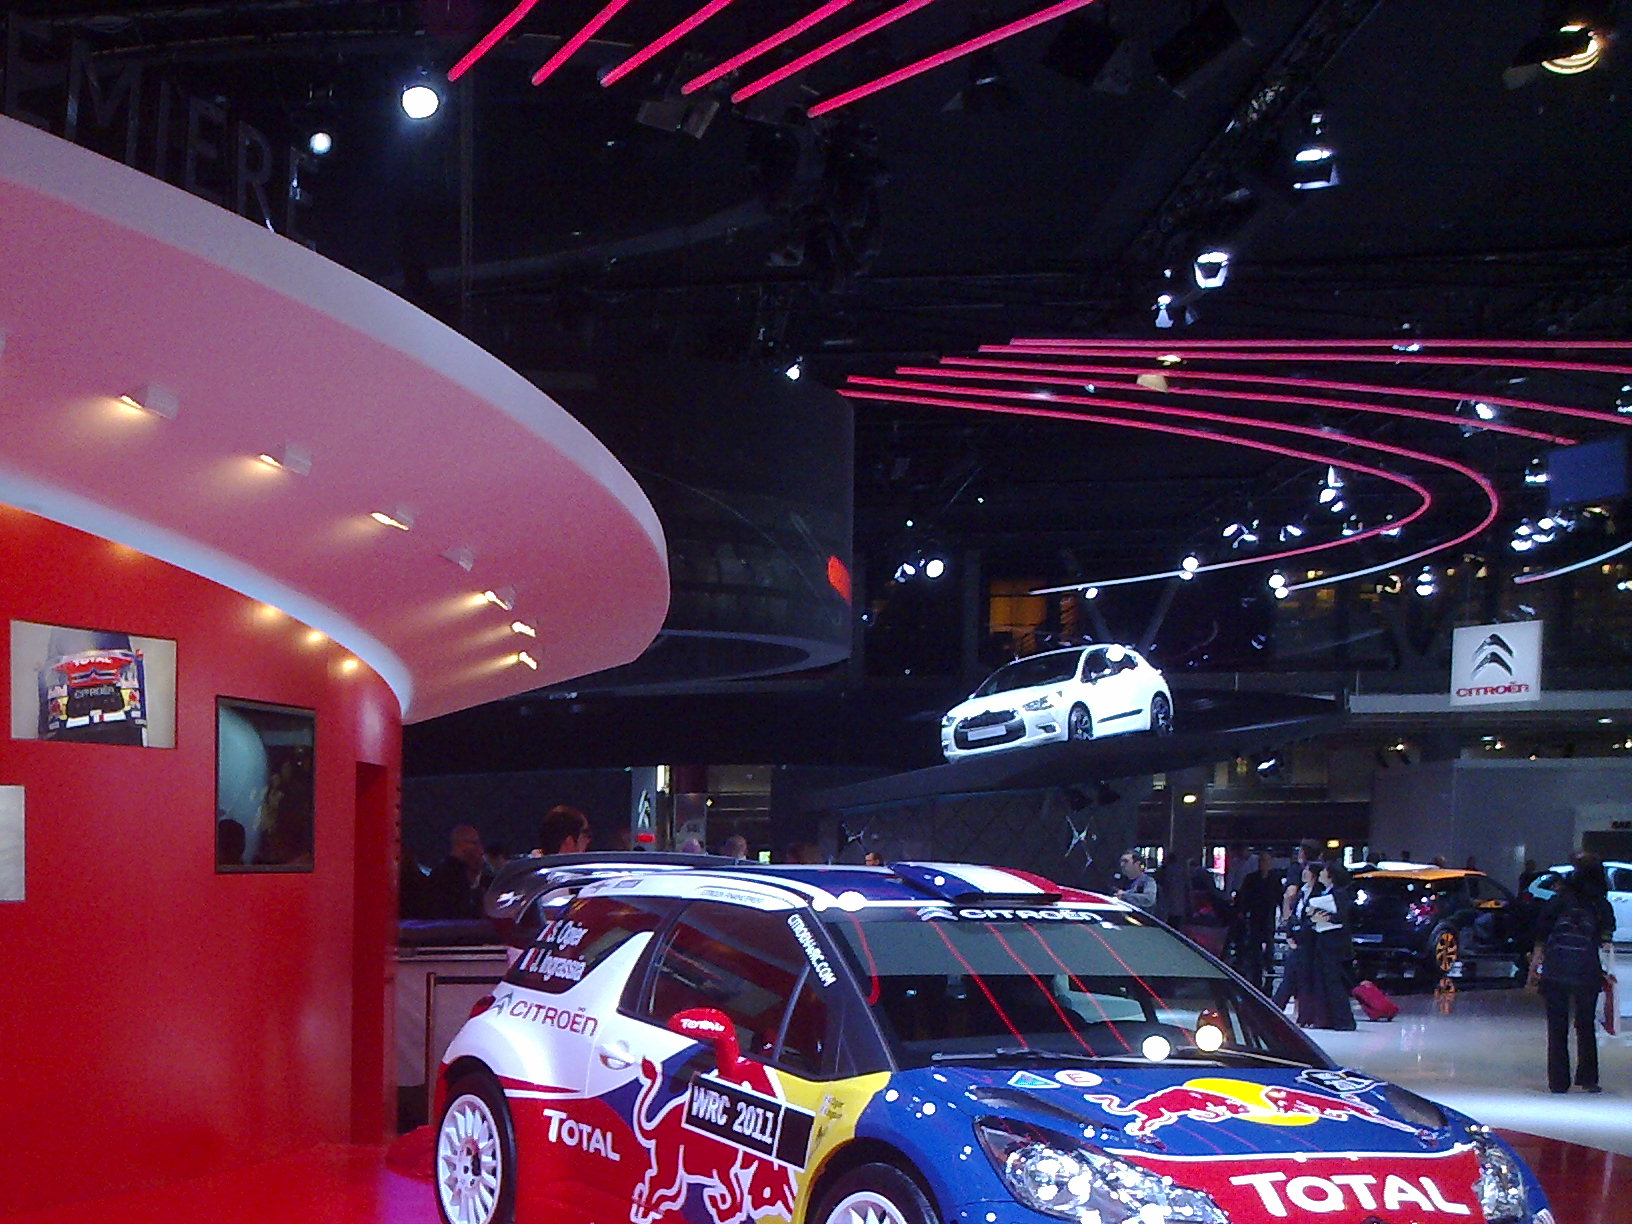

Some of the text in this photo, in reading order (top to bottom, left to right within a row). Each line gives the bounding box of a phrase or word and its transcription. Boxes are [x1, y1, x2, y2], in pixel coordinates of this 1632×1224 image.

[1455, 682, 1529, 698] CITROËN
[959, 908, 1103, 921] CITROËN
[509, 1000, 599, 1037] CITROËN
[543, 1108, 621, 1163] TOTAL
[691, 1085, 732, 1127] WRC
[732, 1101, 775, 1145] 2011
[1230, 1172, 1471, 1217] TOTAL
